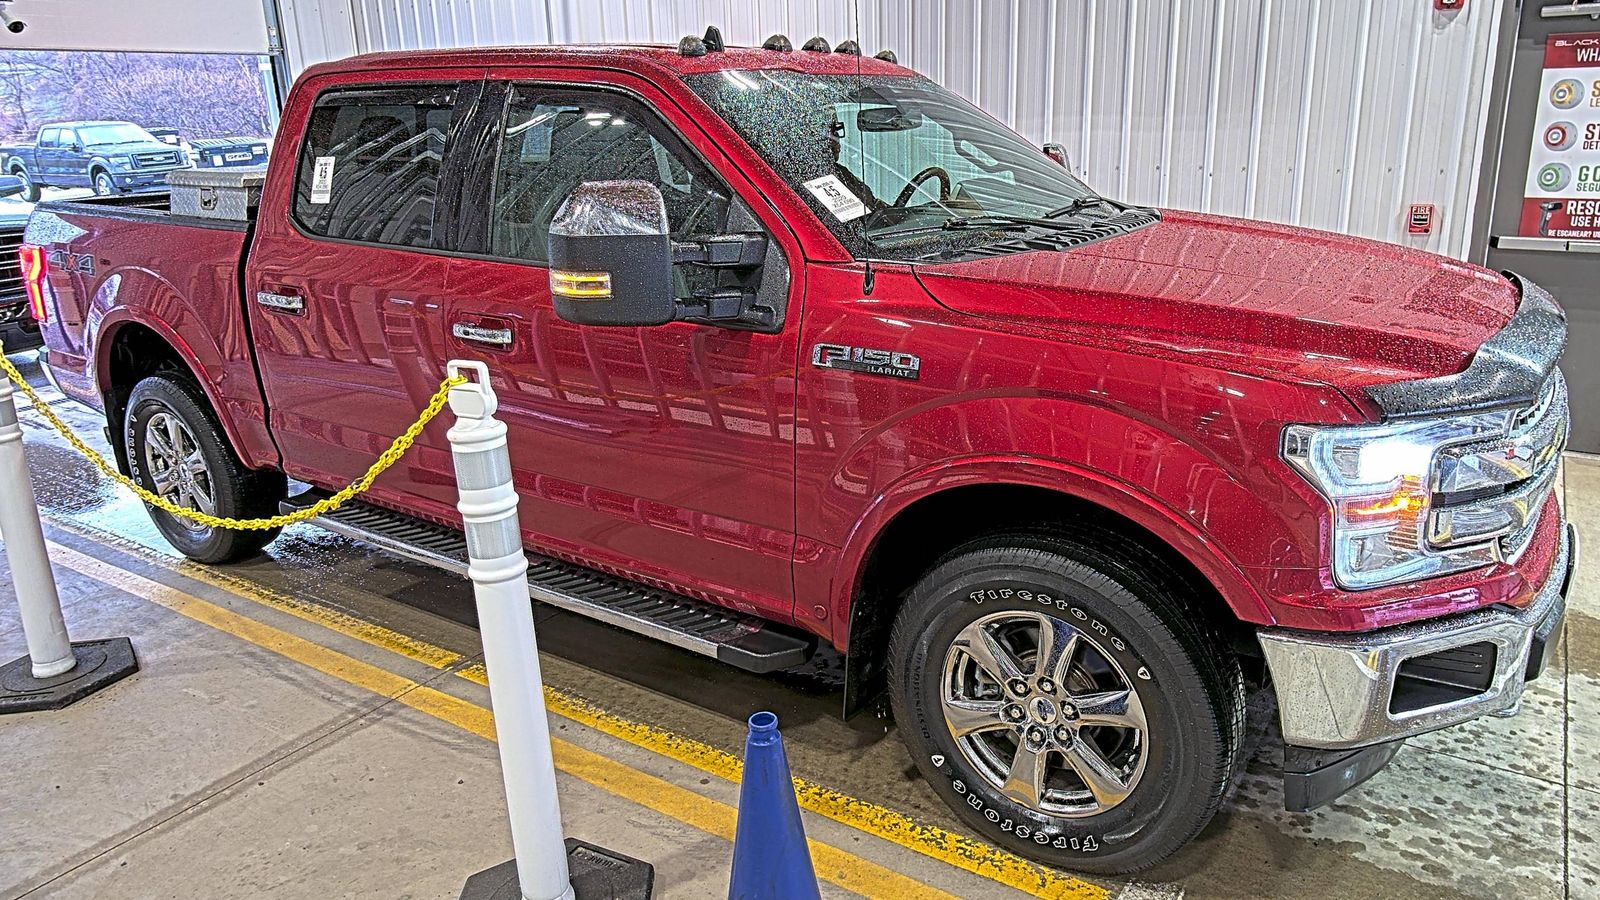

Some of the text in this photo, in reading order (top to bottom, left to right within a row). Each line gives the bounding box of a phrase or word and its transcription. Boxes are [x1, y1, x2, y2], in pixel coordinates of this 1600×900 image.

[1571, 215, 1591, 227] USE
[1557, 230, 1592, 238] ESCANEAR?
[871, 366, 910, 377] LARIAT
[970, 588, 1126, 652] Firestone
[953, 780, 1099, 852] Firestone
